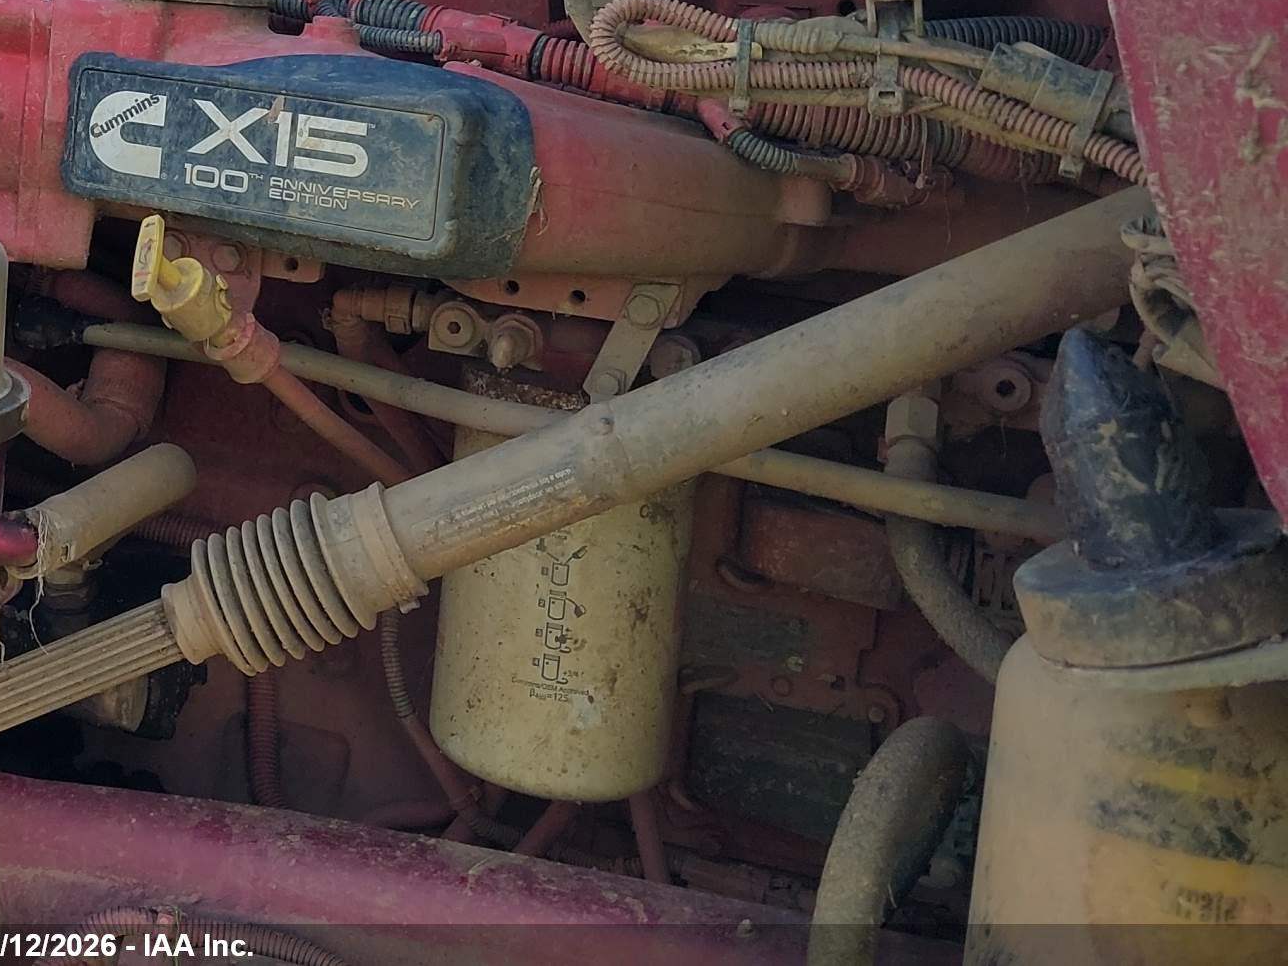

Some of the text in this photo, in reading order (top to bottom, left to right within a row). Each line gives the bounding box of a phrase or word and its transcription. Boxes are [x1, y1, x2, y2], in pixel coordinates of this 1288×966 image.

[90, 93, 160, 139] Cummins
[268, 188, 349, 211] EDITION
[269, 176, 420, 210] ANNIVERSARY
